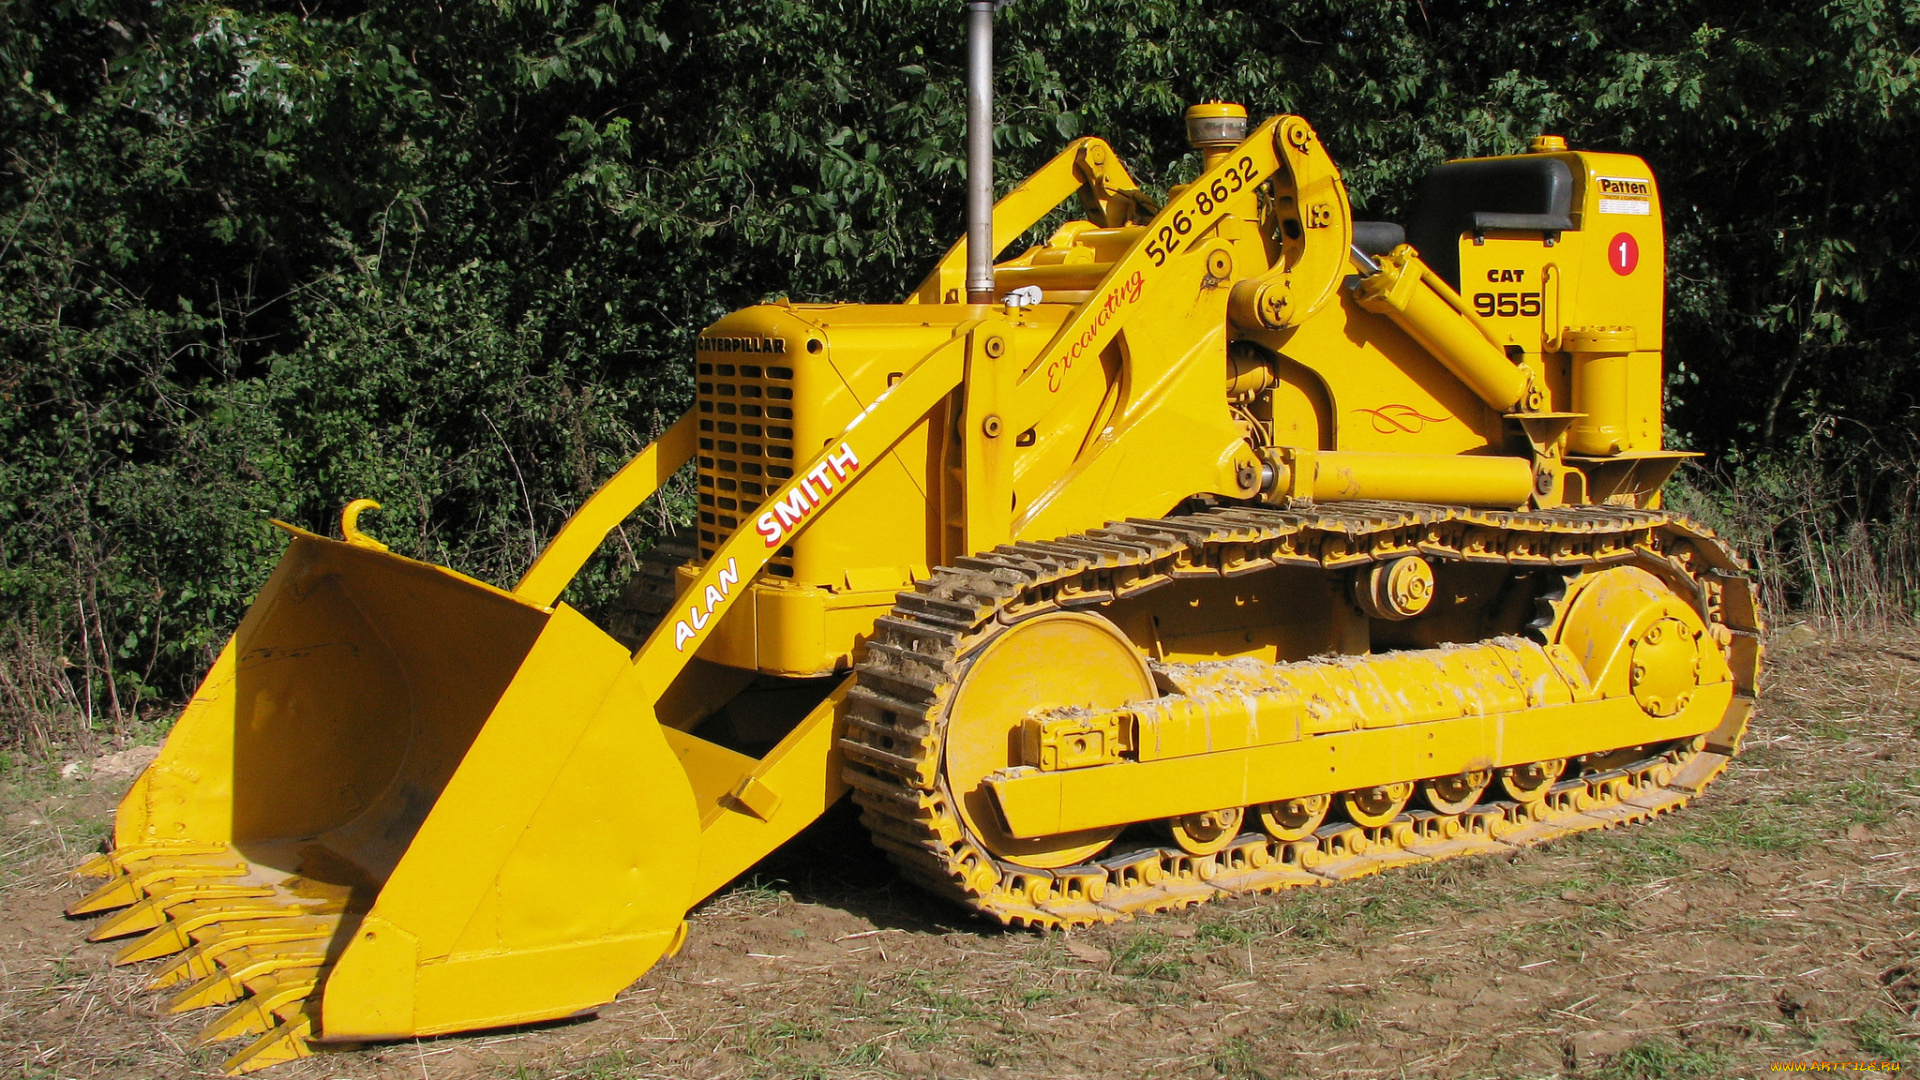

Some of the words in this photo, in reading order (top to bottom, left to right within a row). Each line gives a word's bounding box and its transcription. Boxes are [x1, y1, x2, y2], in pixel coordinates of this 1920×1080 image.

[1600, 179, 1648, 194] Patten
[1619, 242, 1627, 267] 1
[1047, 270, 1145, 393] Excavating
[1144, 156, 1258, 268] 526-8632
[1487, 269, 1524, 283] CAT
[1473, 292, 1541, 317] 955
[698, 336, 786, 354] CATERPILLAR
[674, 557, 740, 652] ALAN
[756, 442, 860, 548] SMITH
